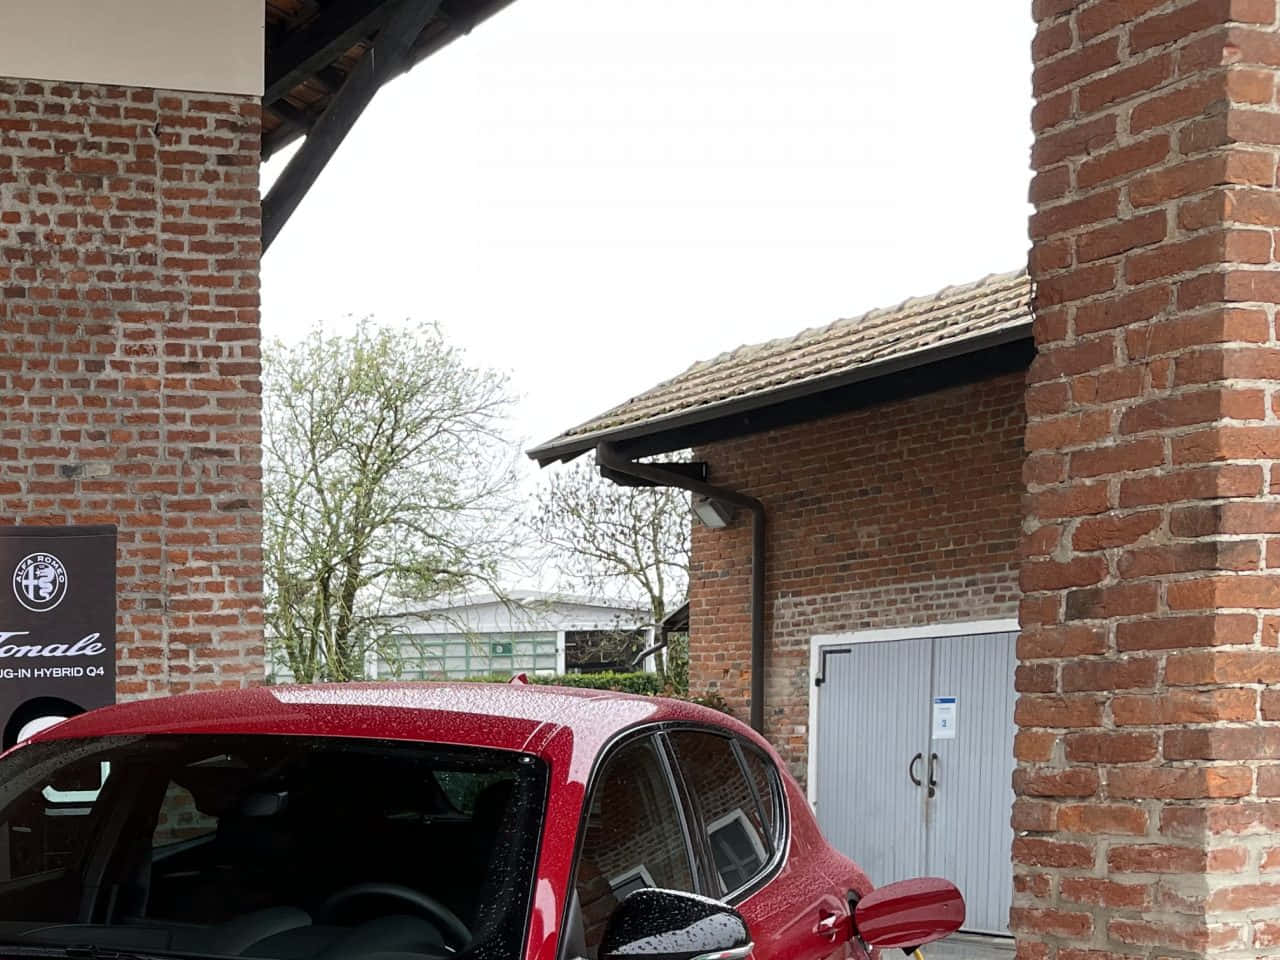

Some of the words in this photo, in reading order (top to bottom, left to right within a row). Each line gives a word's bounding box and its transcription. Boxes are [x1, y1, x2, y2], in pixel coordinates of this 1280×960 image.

[16, 559, 33, 583] ALFA
[37, 555, 65, 583] ROMEO
[34, 666, 84, 678] HYBRID
[86, 666, 105, 677] Q4
